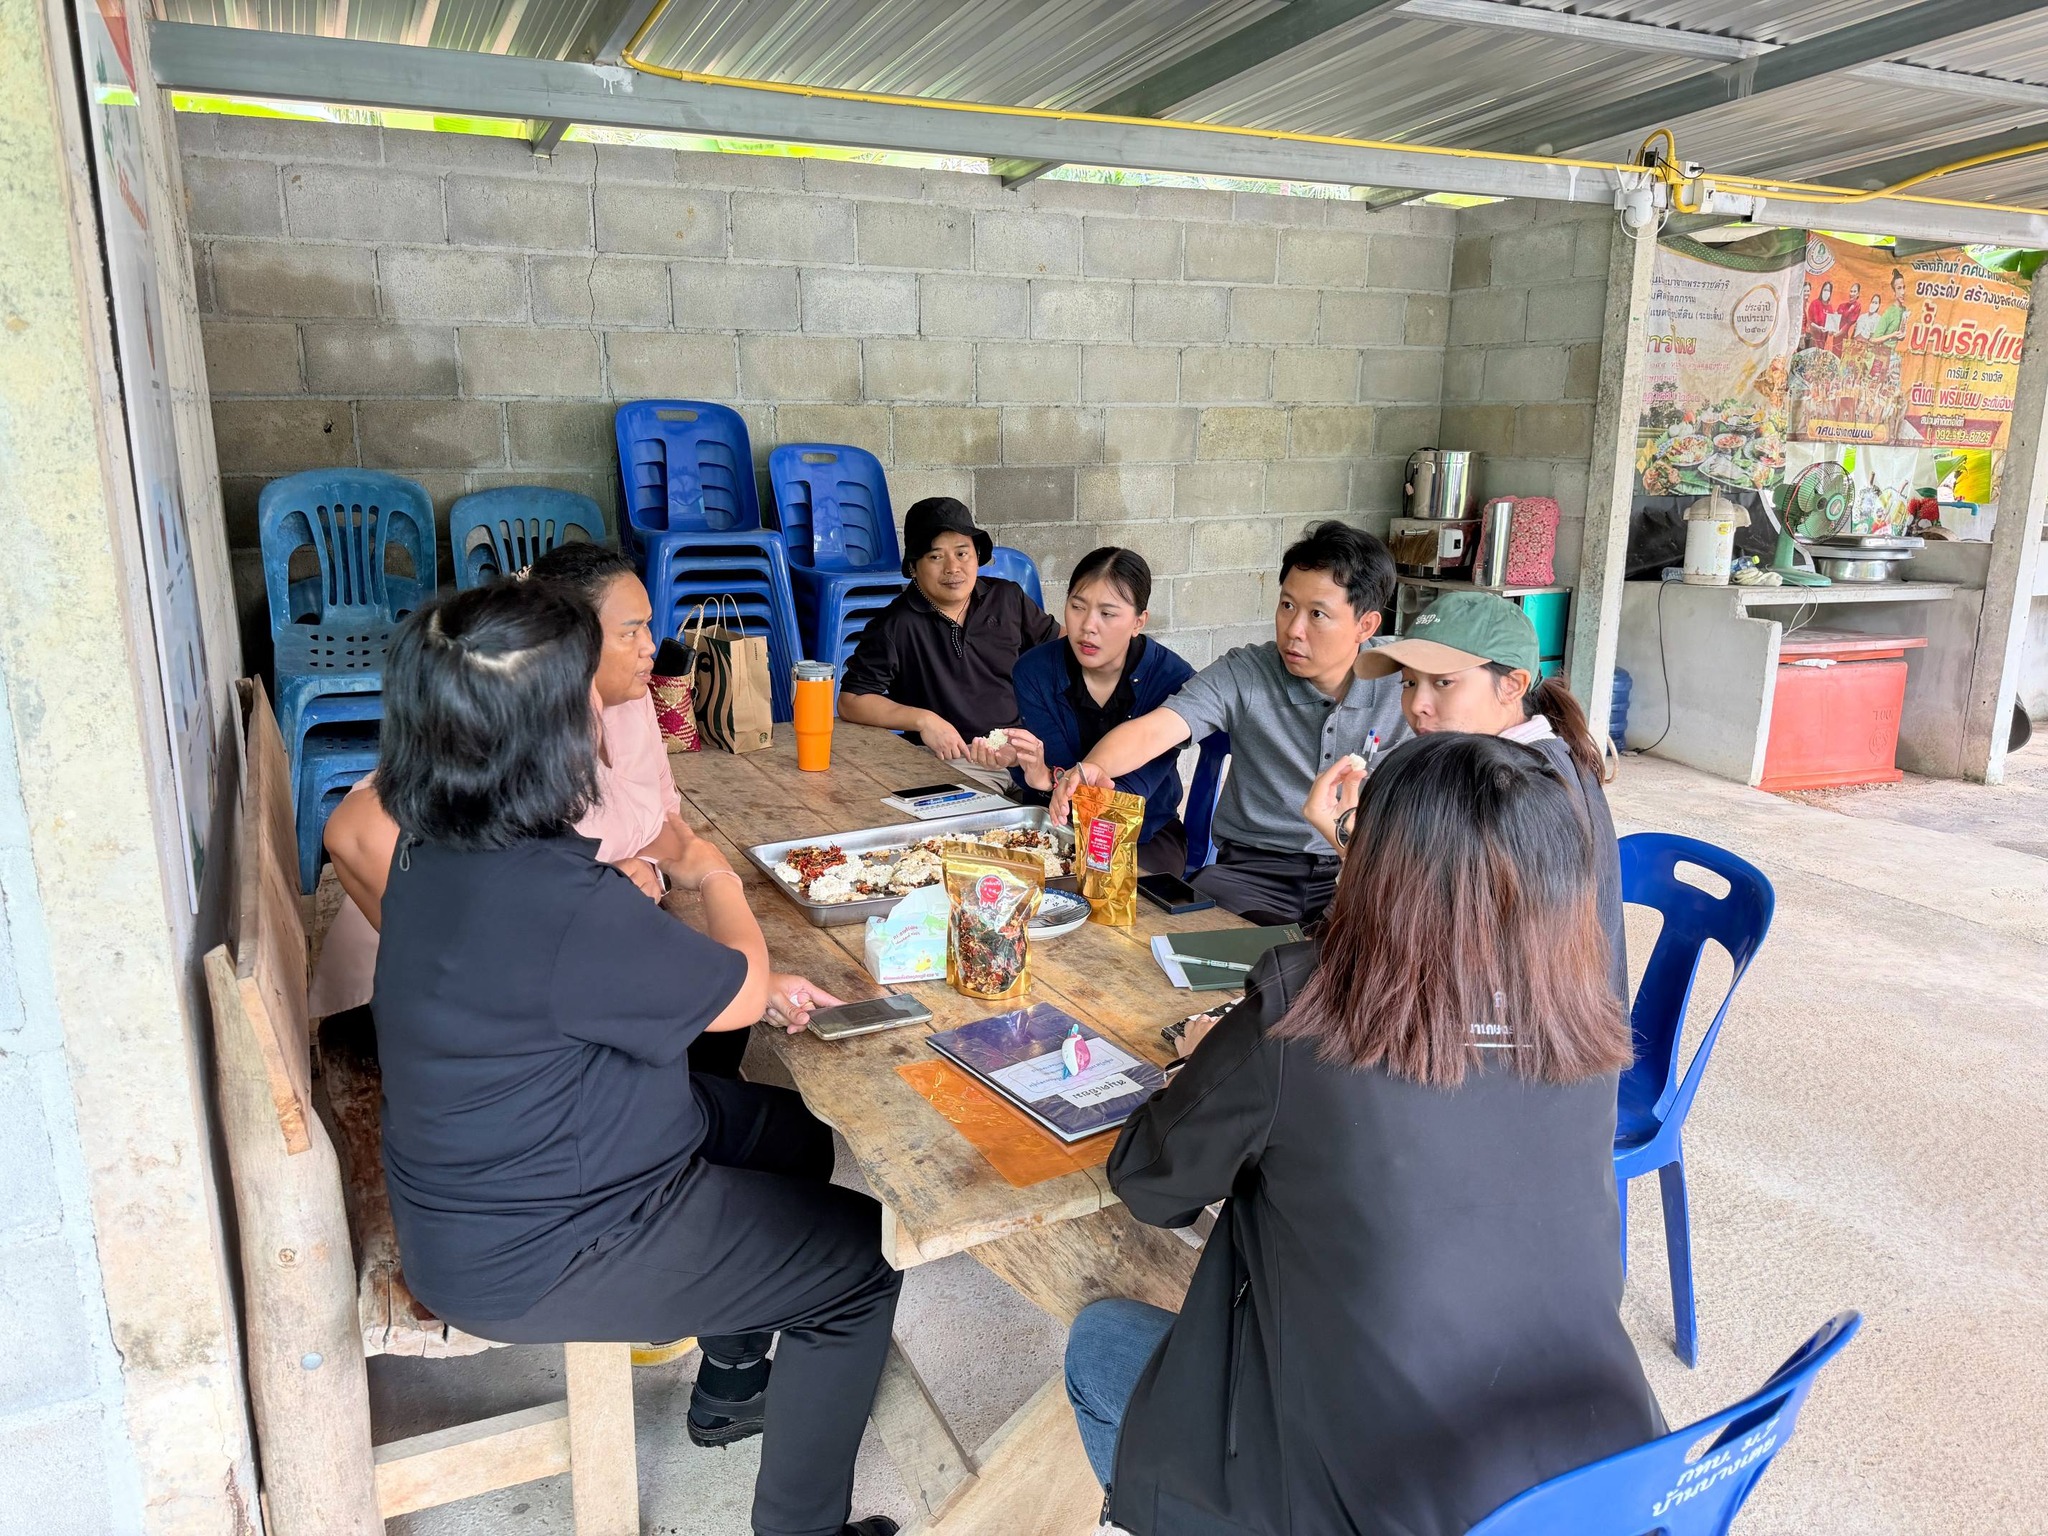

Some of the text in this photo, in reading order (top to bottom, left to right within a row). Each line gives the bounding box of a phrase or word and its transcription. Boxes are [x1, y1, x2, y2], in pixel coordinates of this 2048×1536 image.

[1971, 371, 1978, 380] 2
[1072, 1079, 1127, 1100] สมุดเยี่ยม
